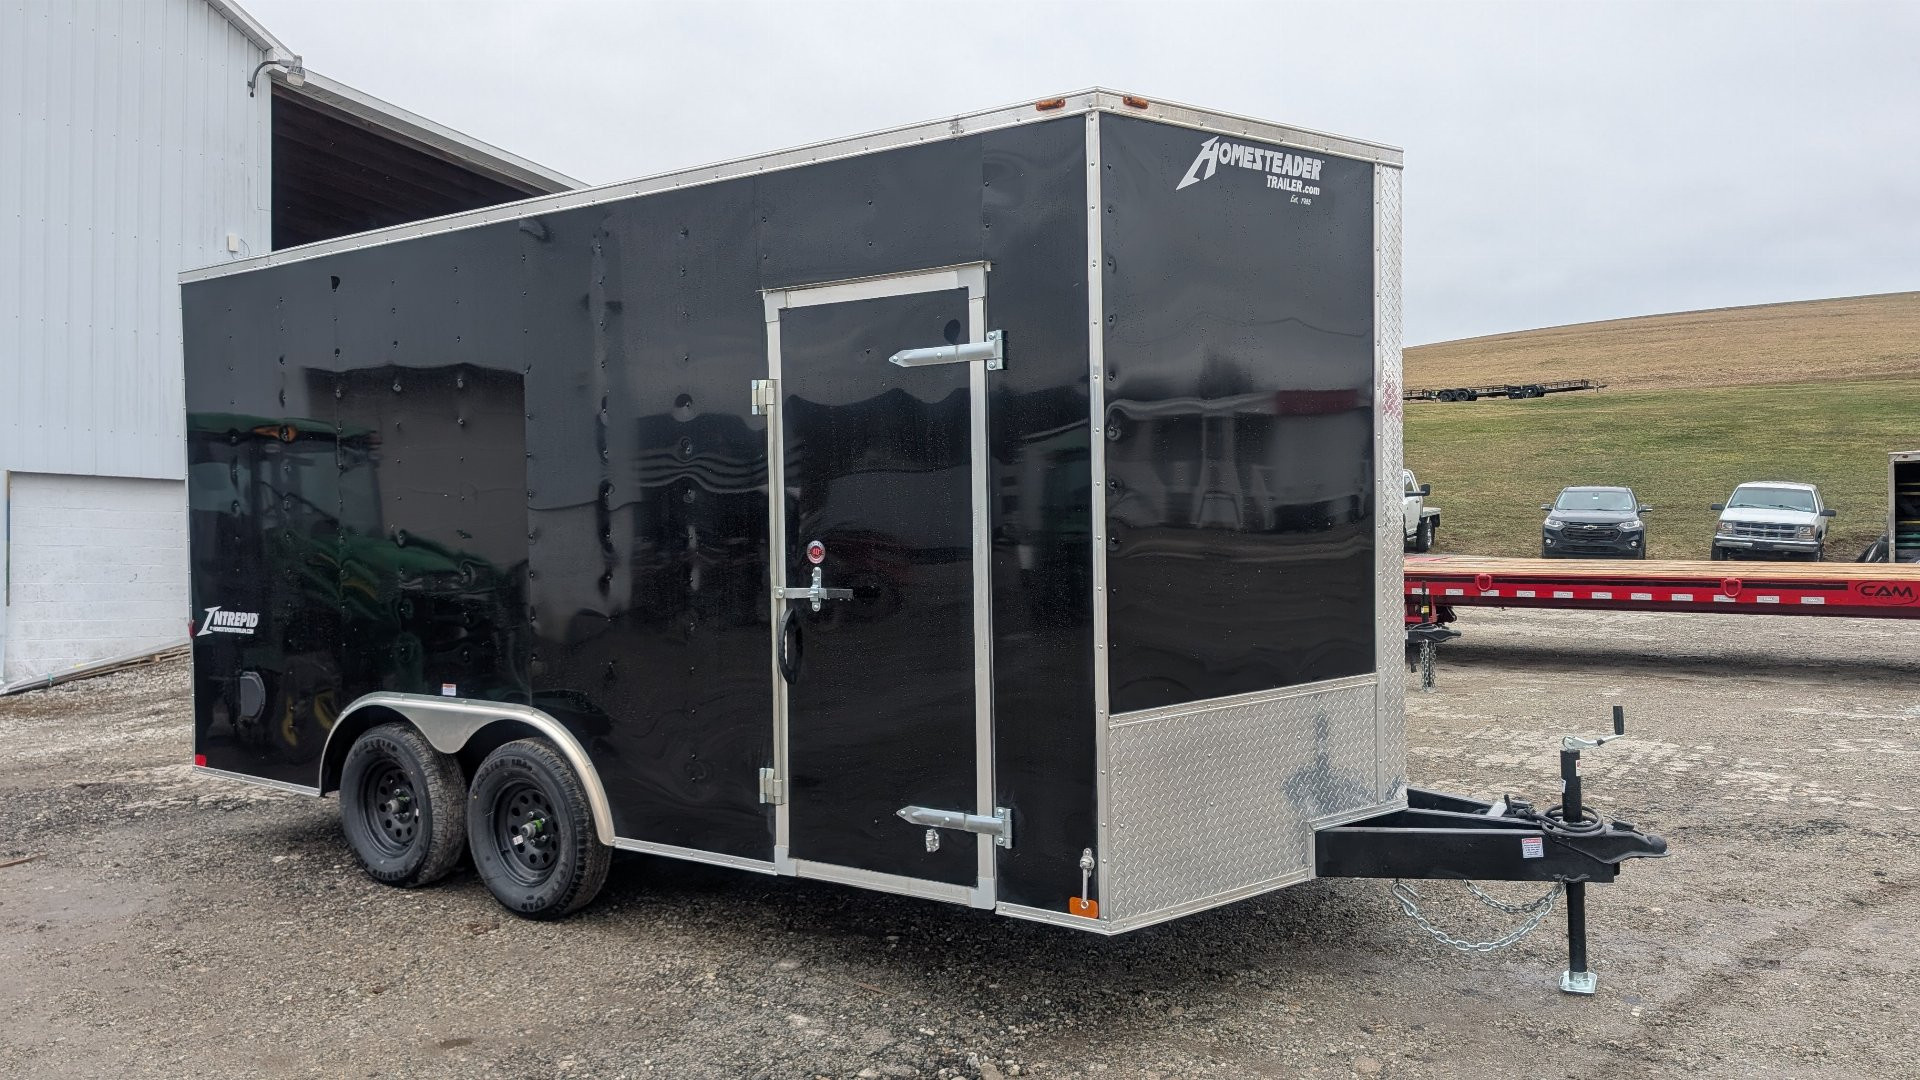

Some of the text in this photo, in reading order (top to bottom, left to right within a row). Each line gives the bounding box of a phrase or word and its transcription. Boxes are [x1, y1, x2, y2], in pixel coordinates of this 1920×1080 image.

[1176, 136, 1322, 190] HOMESTEADER
[1266, 175, 1321, 196] TRAILER.com
[1860, 586, 1913, 597] CAM
[196, 606, 258, 636] INTREPID
